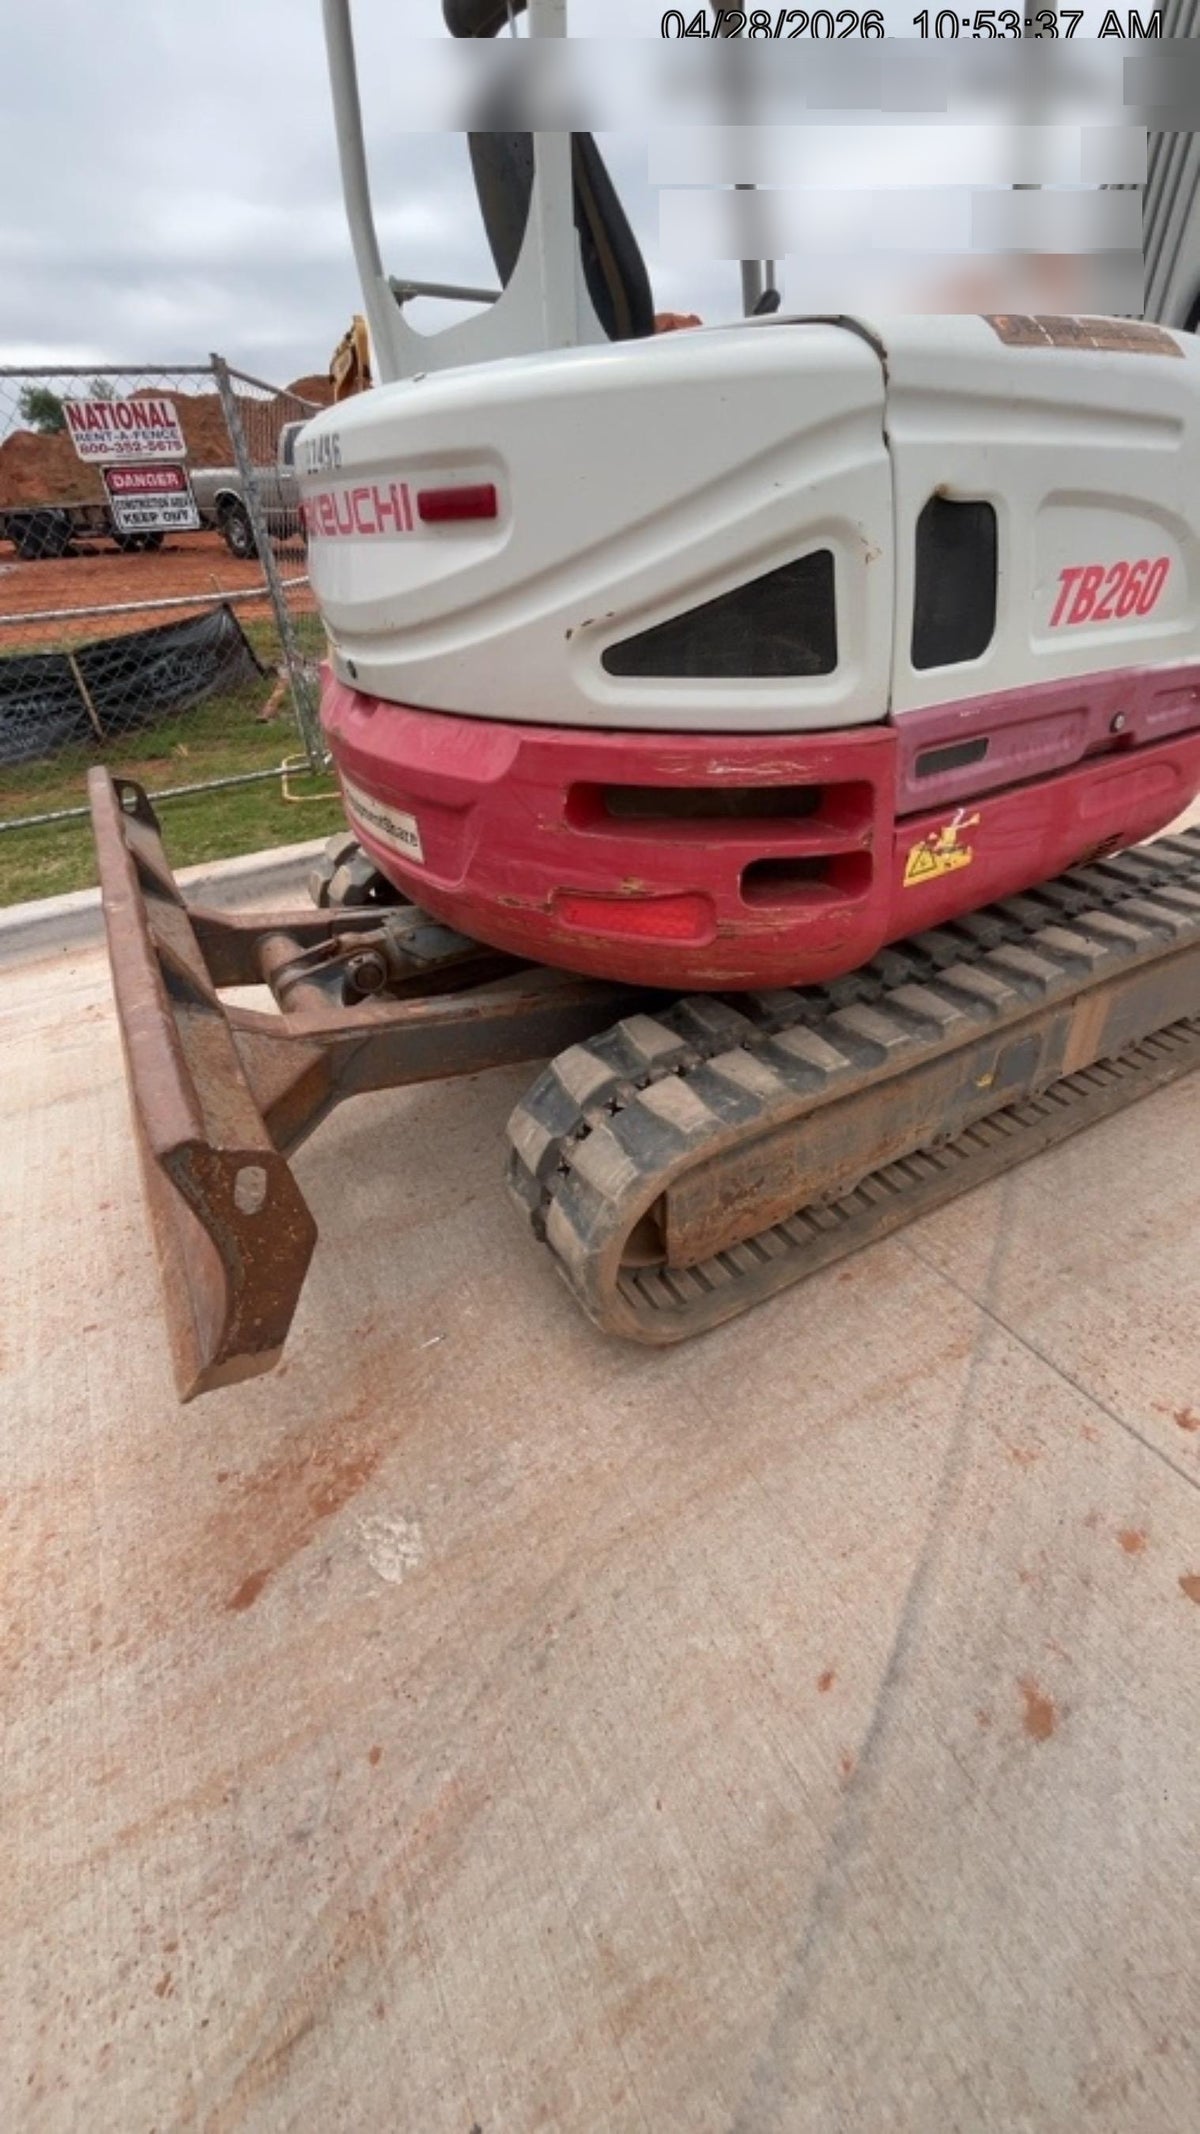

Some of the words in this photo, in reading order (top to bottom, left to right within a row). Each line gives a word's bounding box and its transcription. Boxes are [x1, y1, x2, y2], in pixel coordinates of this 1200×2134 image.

[65, 401, 176, 431] NATIONAL
[112, 471, 179, 488] DANGER
[123, 511, 158, 525] KEEP
[1049, 556, 1170, 627] TB260
